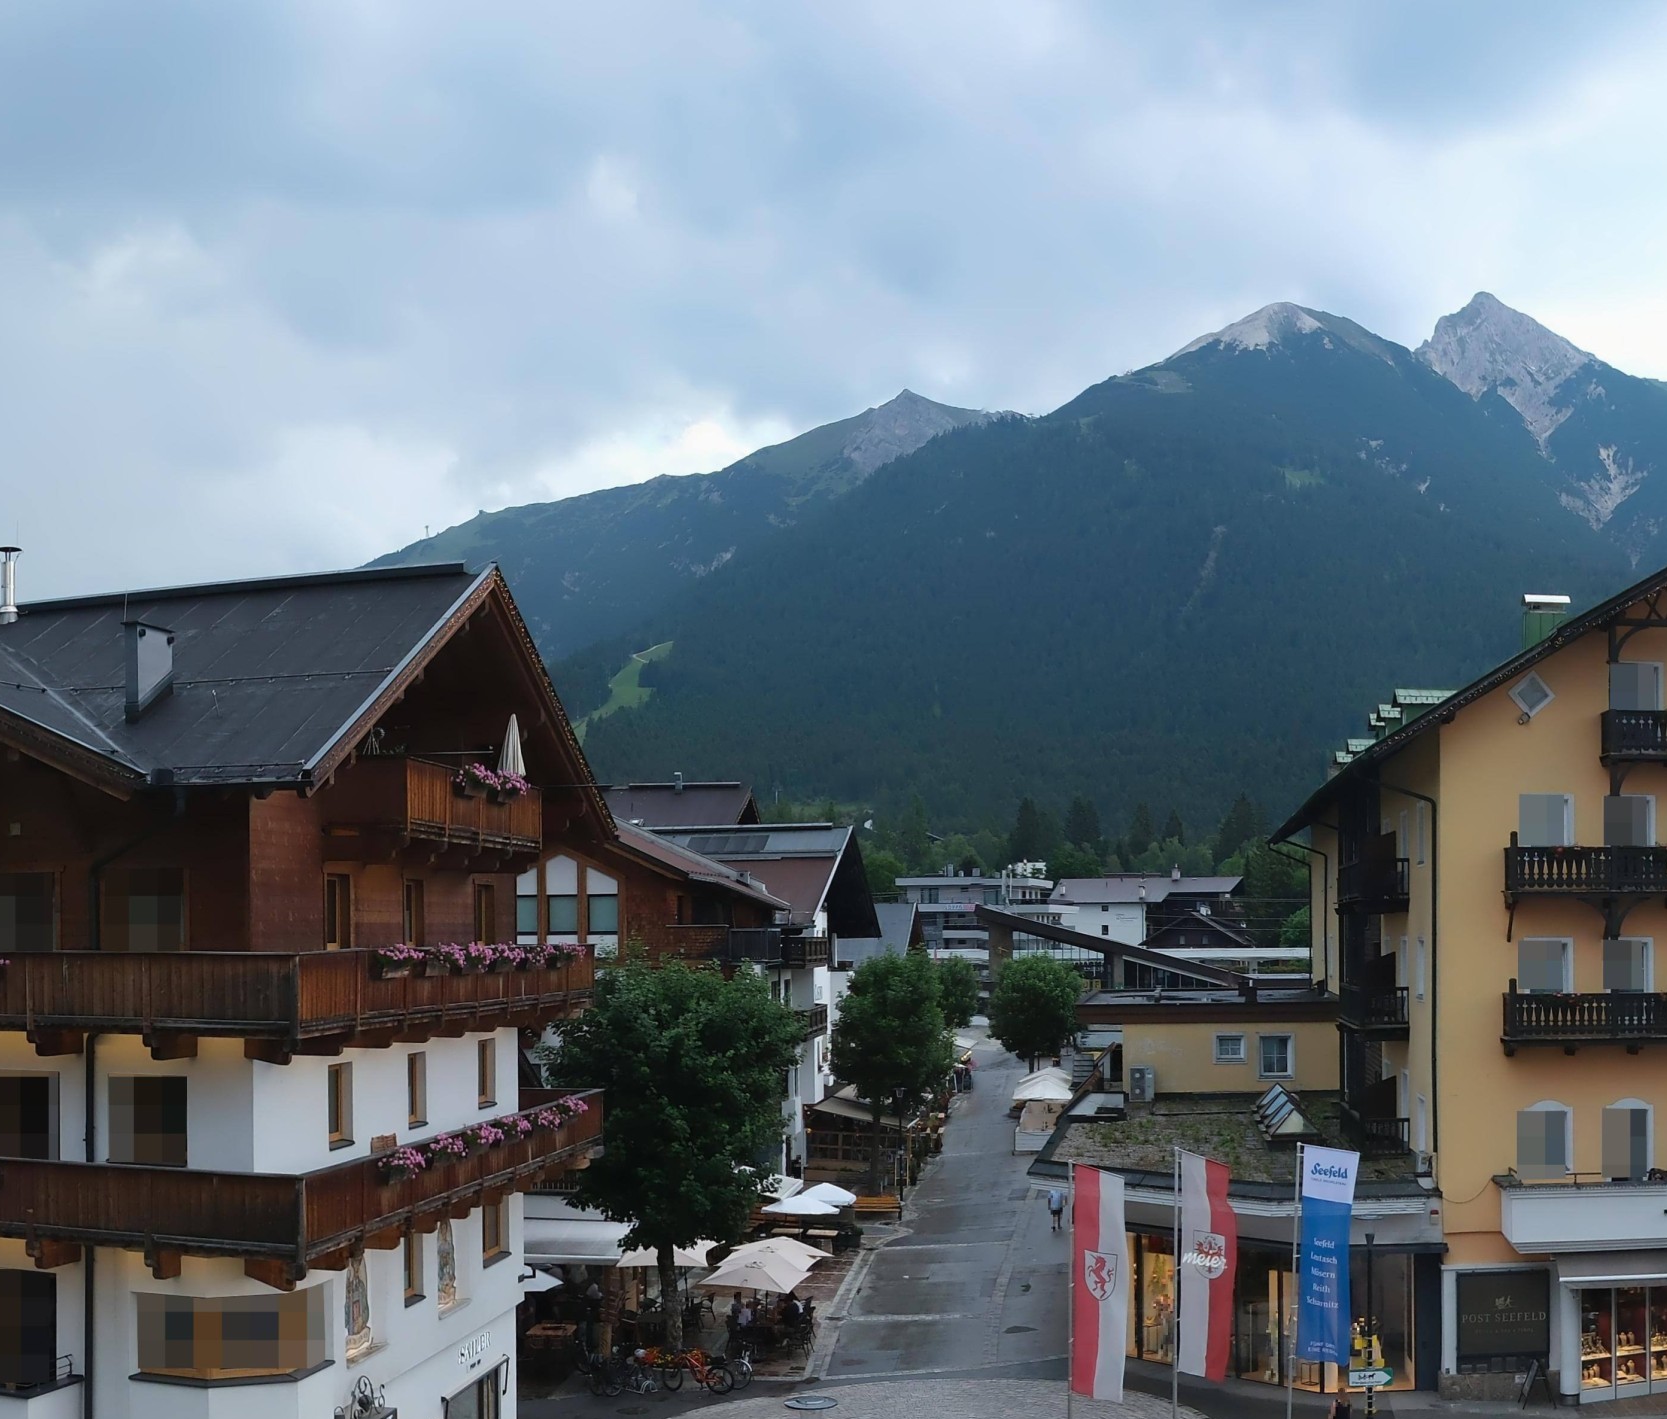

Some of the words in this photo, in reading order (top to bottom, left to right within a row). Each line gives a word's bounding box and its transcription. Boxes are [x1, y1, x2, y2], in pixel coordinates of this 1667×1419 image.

[1311, 1162, 1348, 1179] Seefeld
[1462, 1313, 1491, 1323] POST
[1495, 1311, 1547, 1322] SEEFELD
